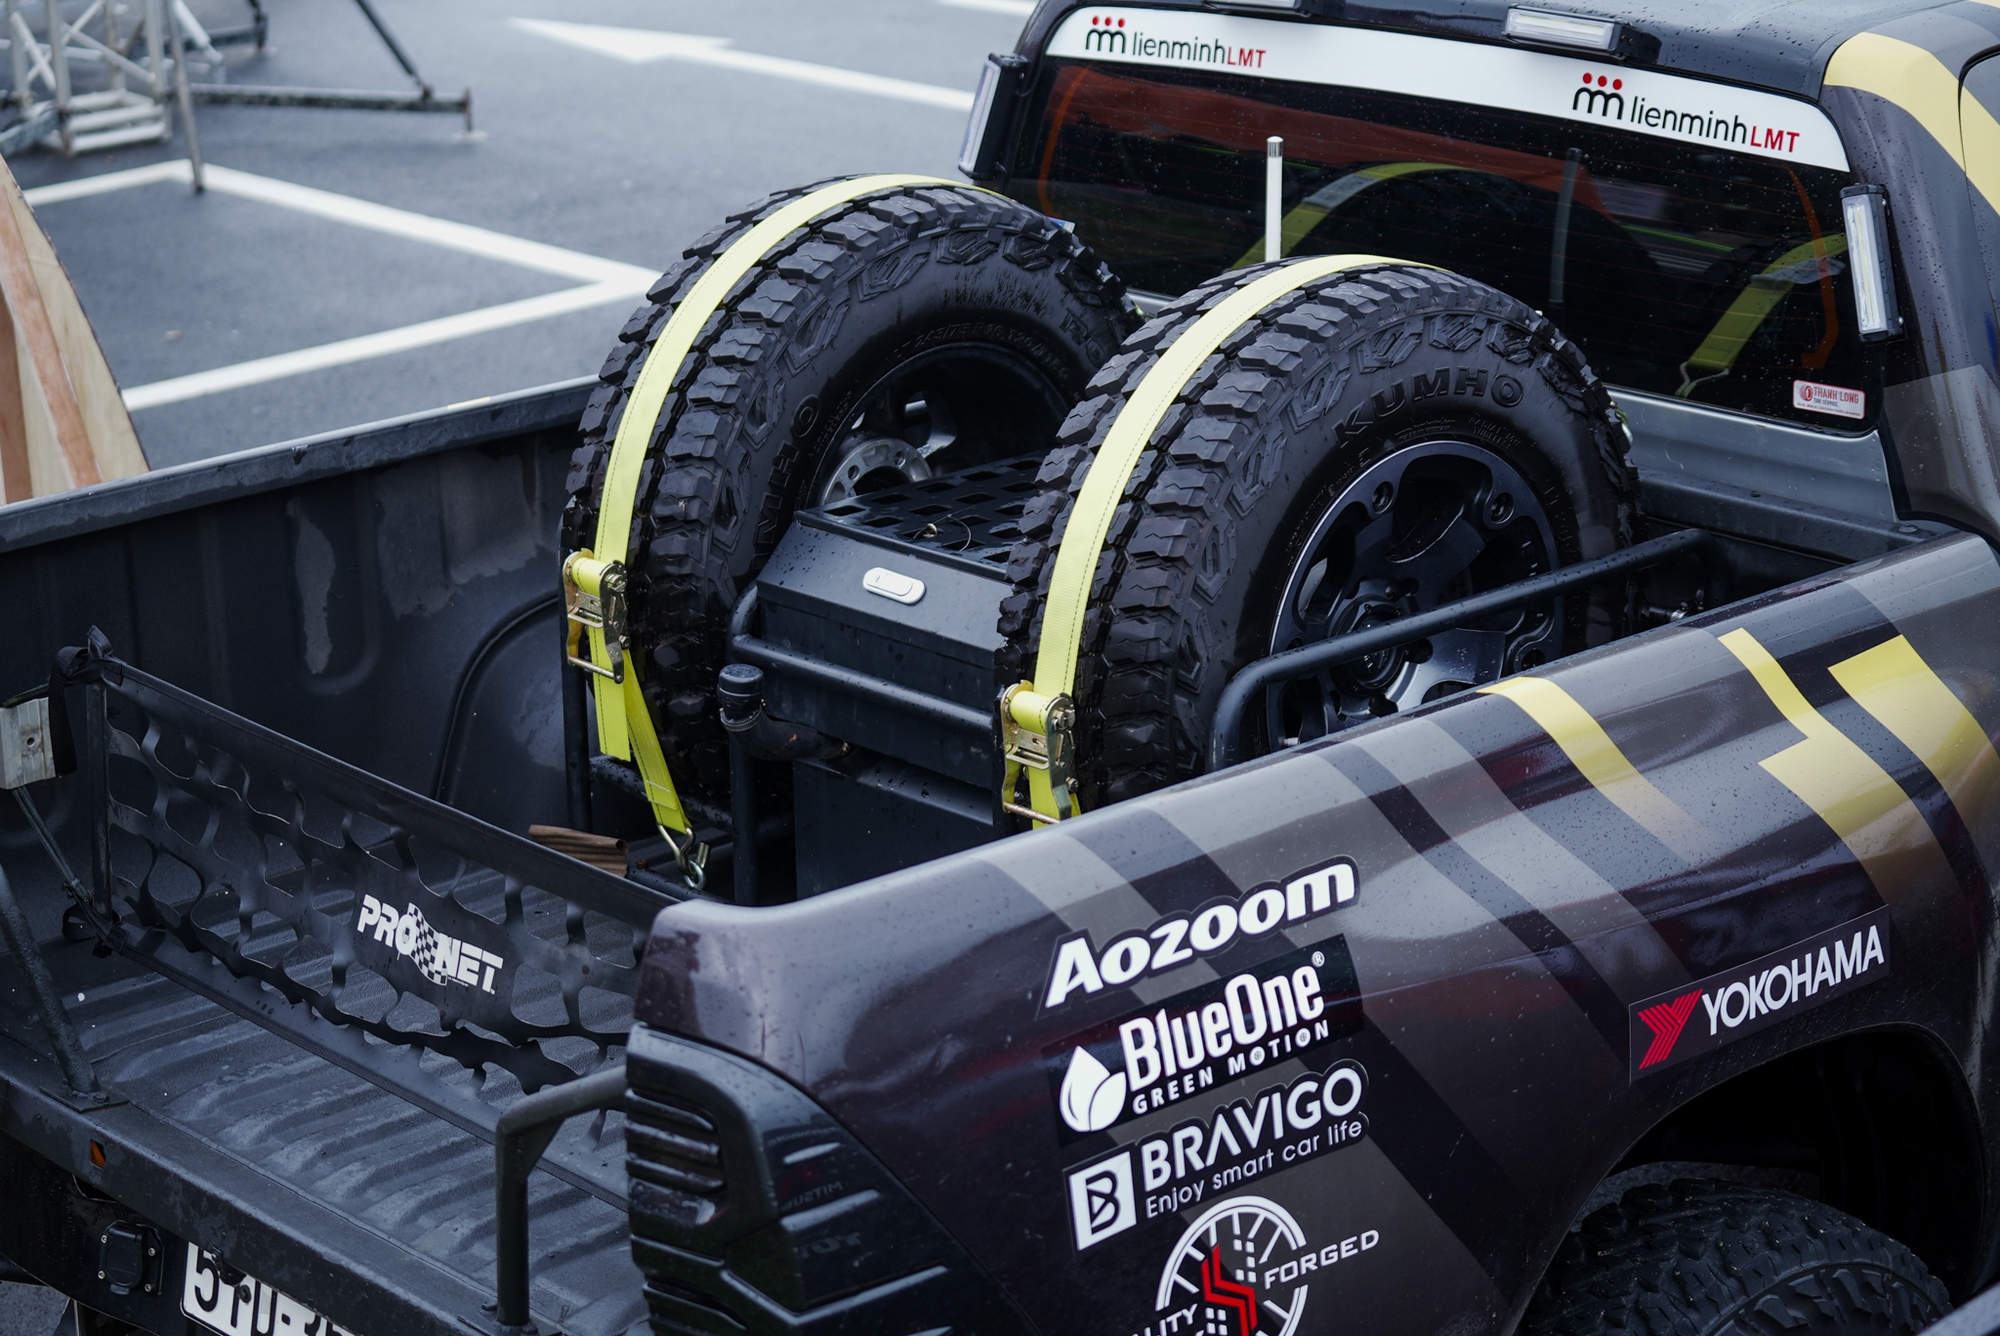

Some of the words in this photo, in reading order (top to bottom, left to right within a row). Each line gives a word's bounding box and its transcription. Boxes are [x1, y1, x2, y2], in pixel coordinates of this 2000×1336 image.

[1131, 32, 1267, 69] lienminhLMT
[1631, 96, 1800, 155] lienminhLMT
[1331, 366, 1524, 449] KUMHO
[1840, 391, 1859, 404] LONG
[1045, 863, 1355, 1008] Aozoom
[1702, 925, 1885, 1036] YOKOHAMA
[1133, 1066, 1213, 1114] GREEN
[1228, 1020, 1329, 1077] MOTION
[1142, 1067, 1362, 1192] BRAVIGO
[1146, 1181, 1204, 1218] Enjoy
[1212, 1150, 1273, 1190] smart
[1282, 1133, 1319, 1161] car
[1328, 1118, 1362, 1147] life
[1264, 1229, 1380, 1290] FORGED
